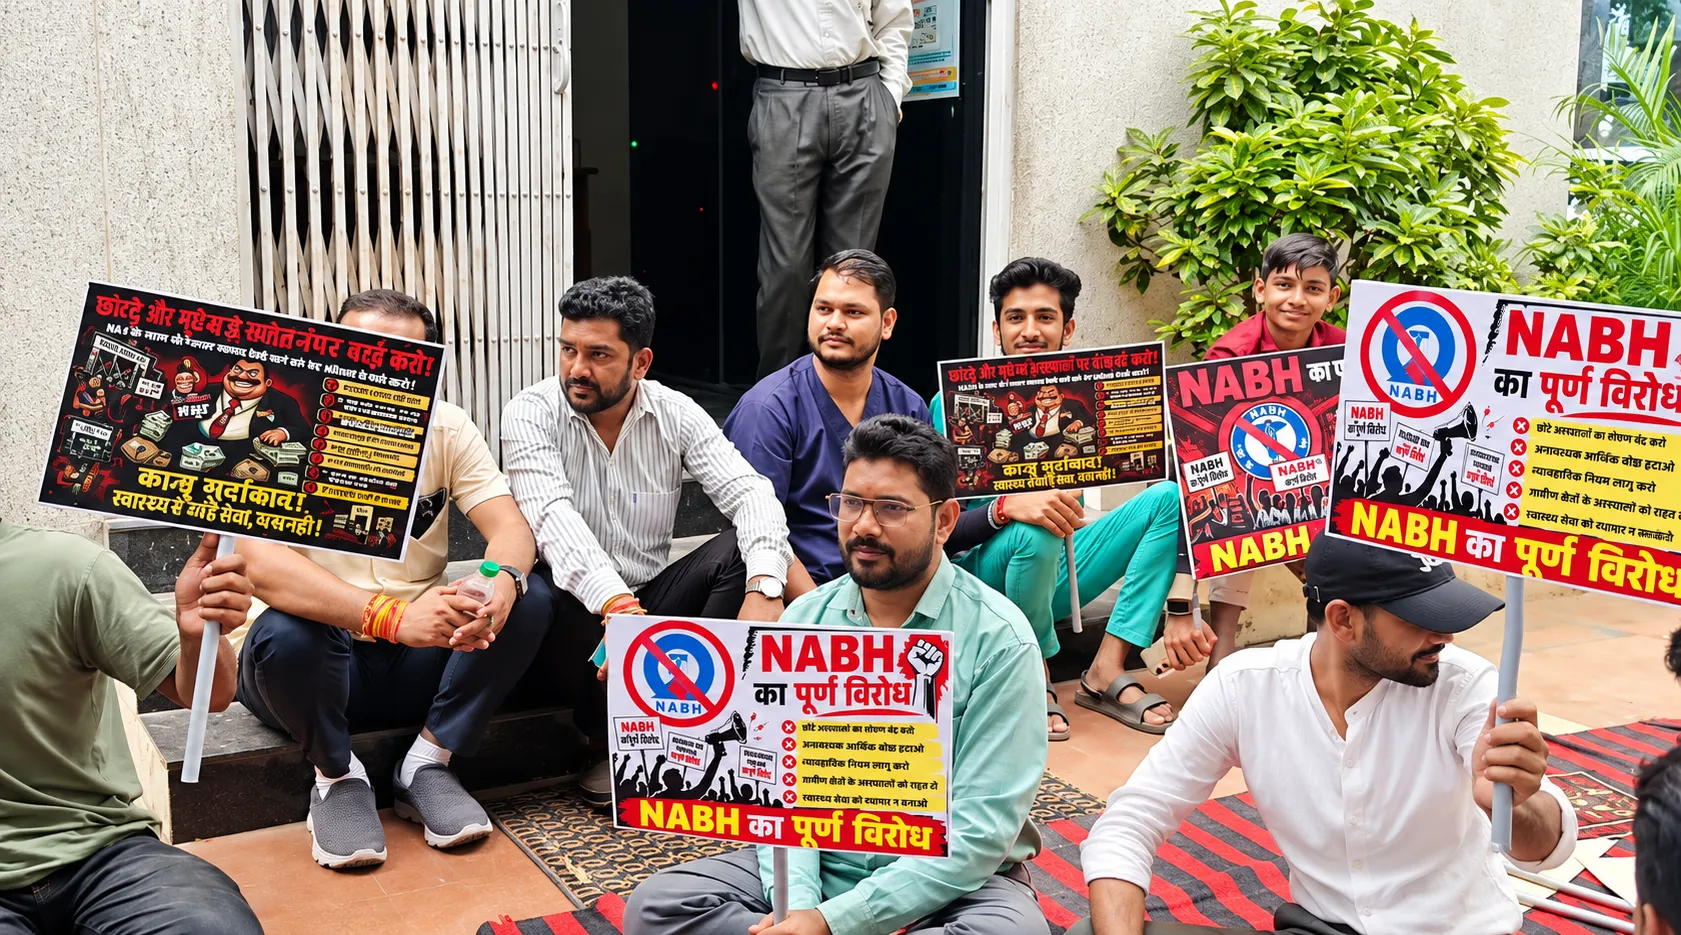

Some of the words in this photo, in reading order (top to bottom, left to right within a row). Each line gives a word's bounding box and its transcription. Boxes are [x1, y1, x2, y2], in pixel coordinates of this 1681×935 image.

[1505, 308, 1673, 370] NABH
[1177, 355, 1304, 408] NABH
[1305, 361, 1333, 384] का
[1493, 367, 1533, 399] का
[1539, 365, 1595, 413] पूर्ण
[1388, 384, 1438, 404] NABH
[1351, 406, 1384, 420] NABH
[1593, 430, 1606, 441] का
[1649, 436, 1667, 448] करो
[1190, 457, 1223, 475] NABH
[1278, 459, 1316, 477] NABH
[1584, 471, 1610, 486] नियम
[1636, 480, 1657, 493] करो
[1581, 494, 1592, 506] के
[1638, 503, 1652, 516] को
[1560, 513, 1579, 527] सेवा
[1580, 518, 1594, 529] को
[1628, 526, 1636, 537] न
[1210, 524, 1311, 573] NABH
[1350, 500, 1458, 555] NABH
[1464, 528, 1507, 564] का
[1514, 533, 1580, 579] पूर्ण
[761, 634, 896, 673] NABH
[753, 682, 787, 706] का
[793, 675, 841, 714] पूर्ण
[844, 675, 912, 707] विरोध
[655, 700, 702, 715] NABH
[620, 721, 655, 733] NABH
[639, 800, 740, 836] NABH
[747, 813, 784, 840] का
[792, 806, 843, 849] पूर्ण
[852, 808, 933, 851] विरोध
